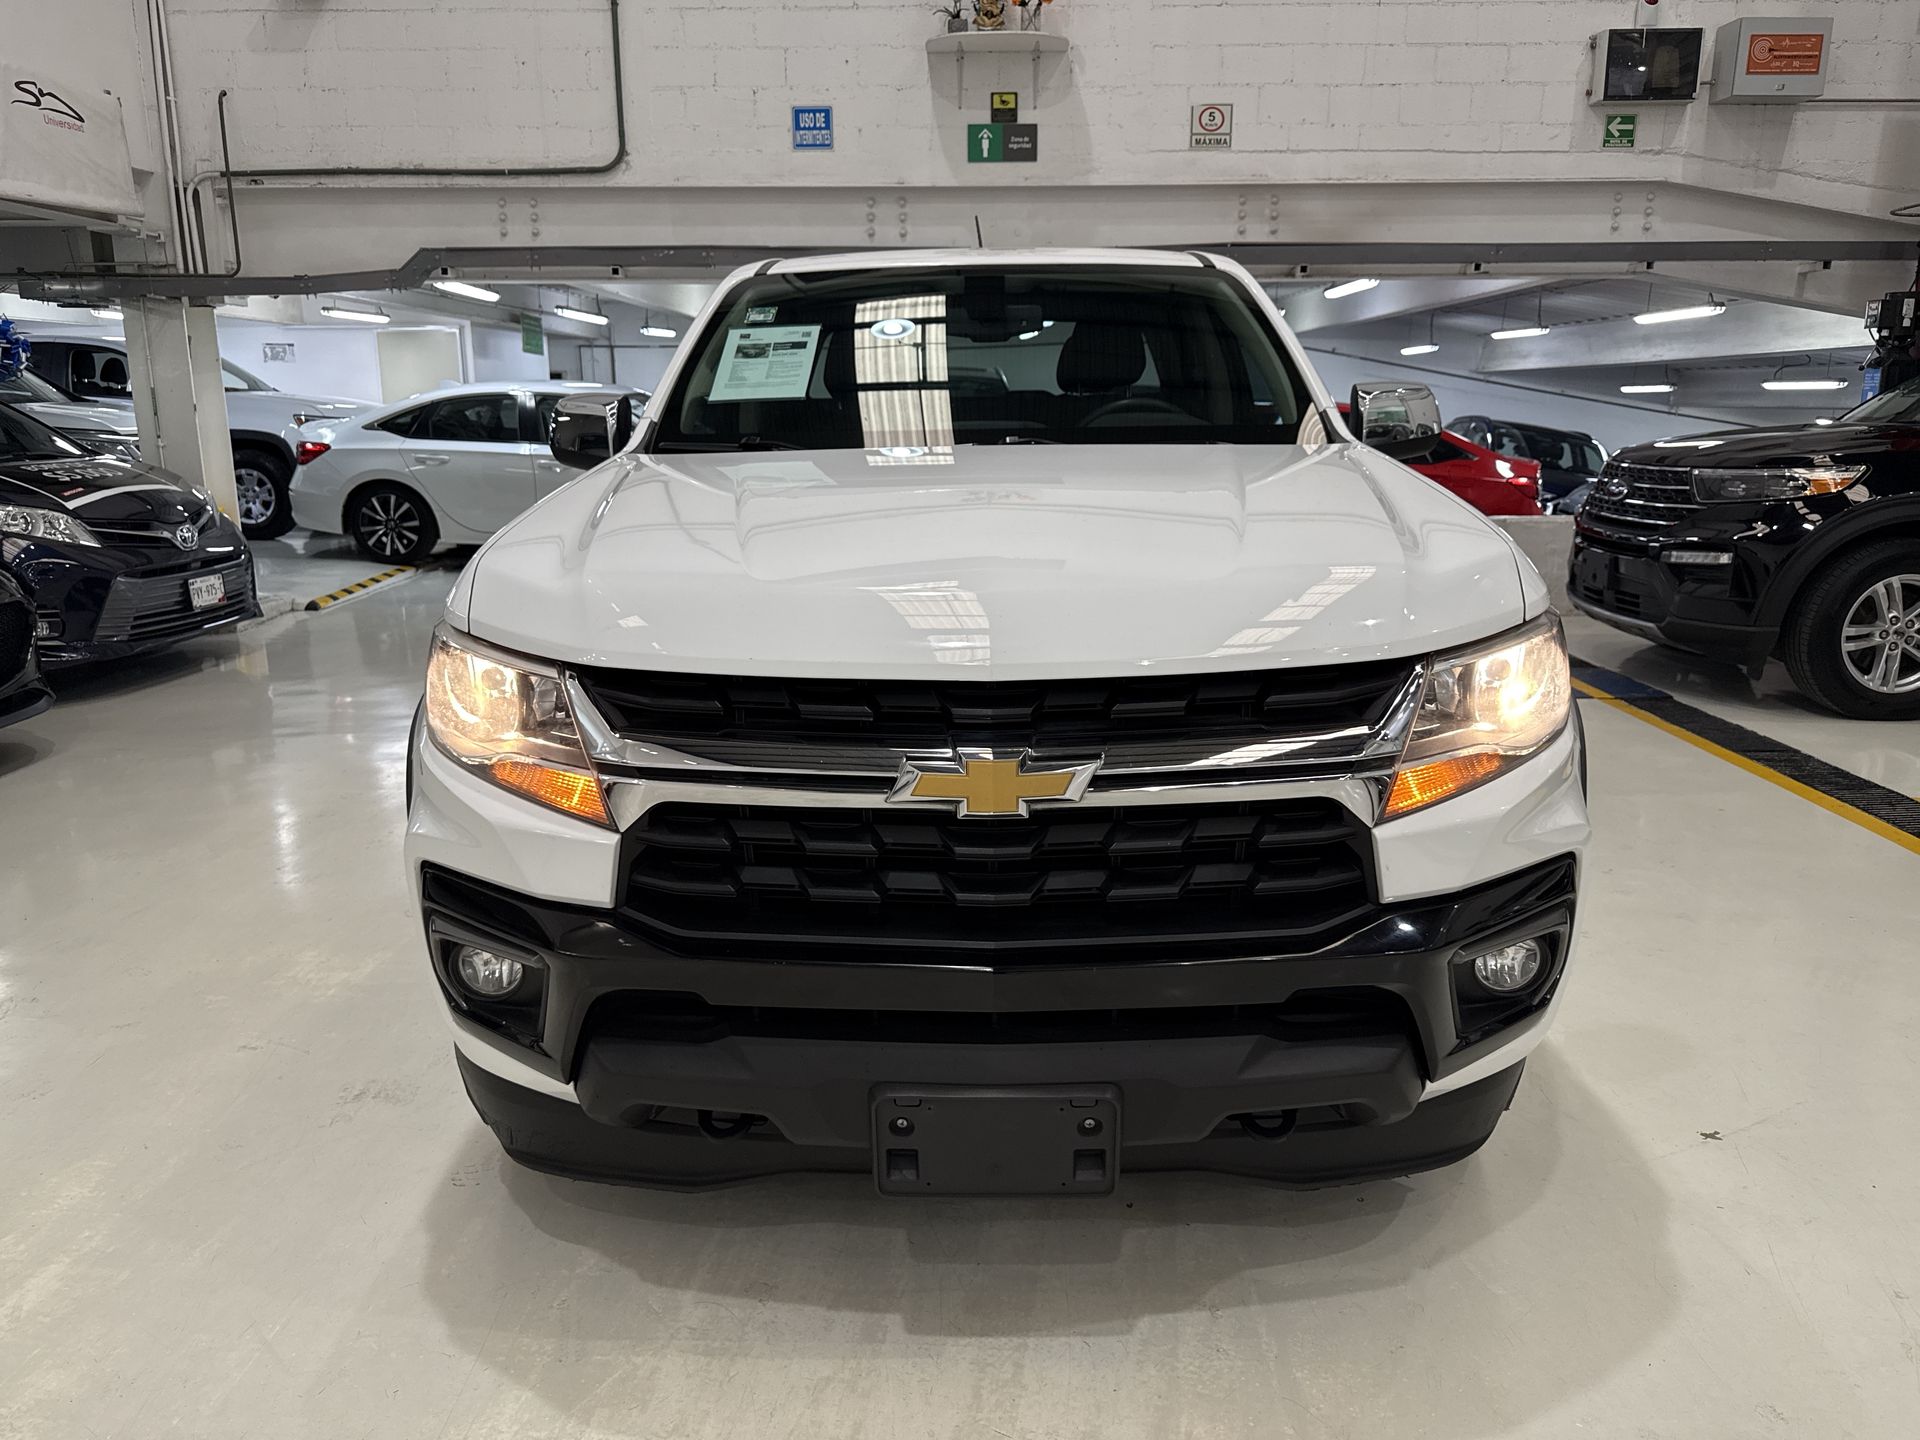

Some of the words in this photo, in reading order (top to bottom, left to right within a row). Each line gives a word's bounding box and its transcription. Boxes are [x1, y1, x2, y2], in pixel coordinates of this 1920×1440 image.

[43, 113, 85, 133] Universidad
[799, 112, 815, 128] USO
[815, 112, 826, 128] DE
[1208, 111, 1216, 122] 5
[1194, 136, 1228, 145] MÁXIMA
